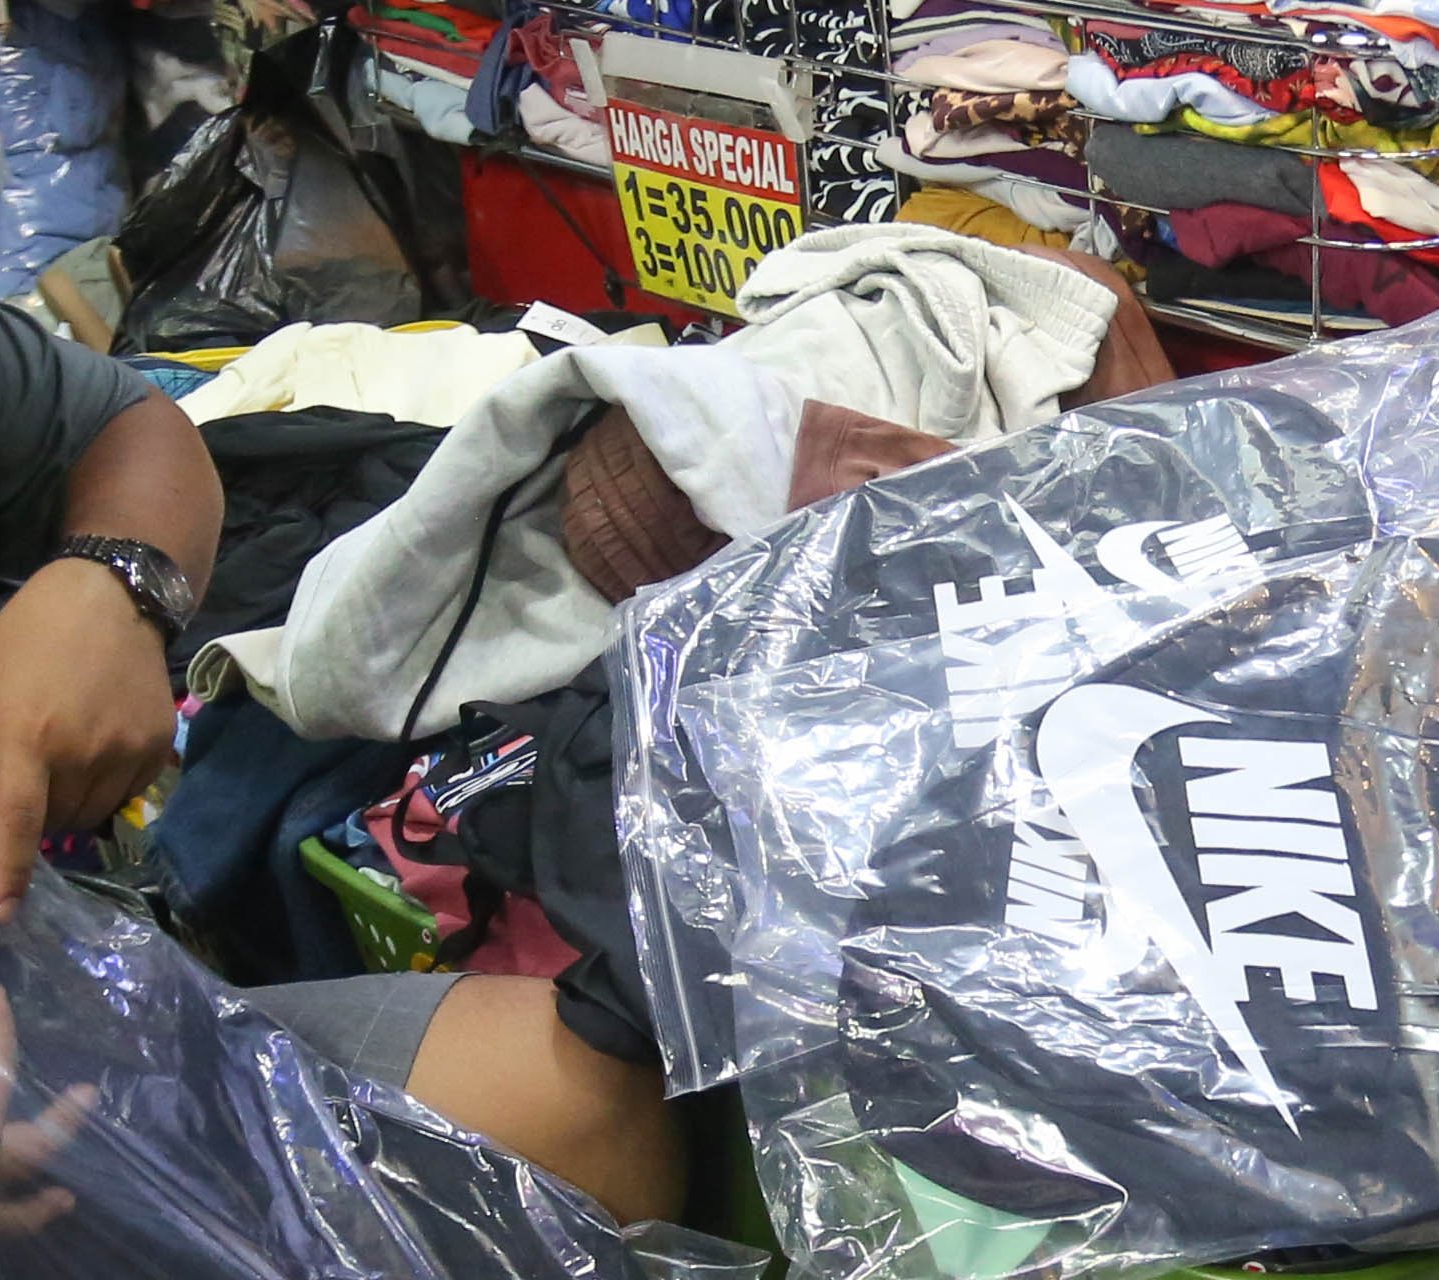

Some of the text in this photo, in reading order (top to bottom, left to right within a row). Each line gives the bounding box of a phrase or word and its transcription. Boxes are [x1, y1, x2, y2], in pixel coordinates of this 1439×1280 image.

[609, 107, 690, 172] HARGA
[689, 126, 795, 195] SPECIAL
[1178, 736, 1379, 1011] NIKE
